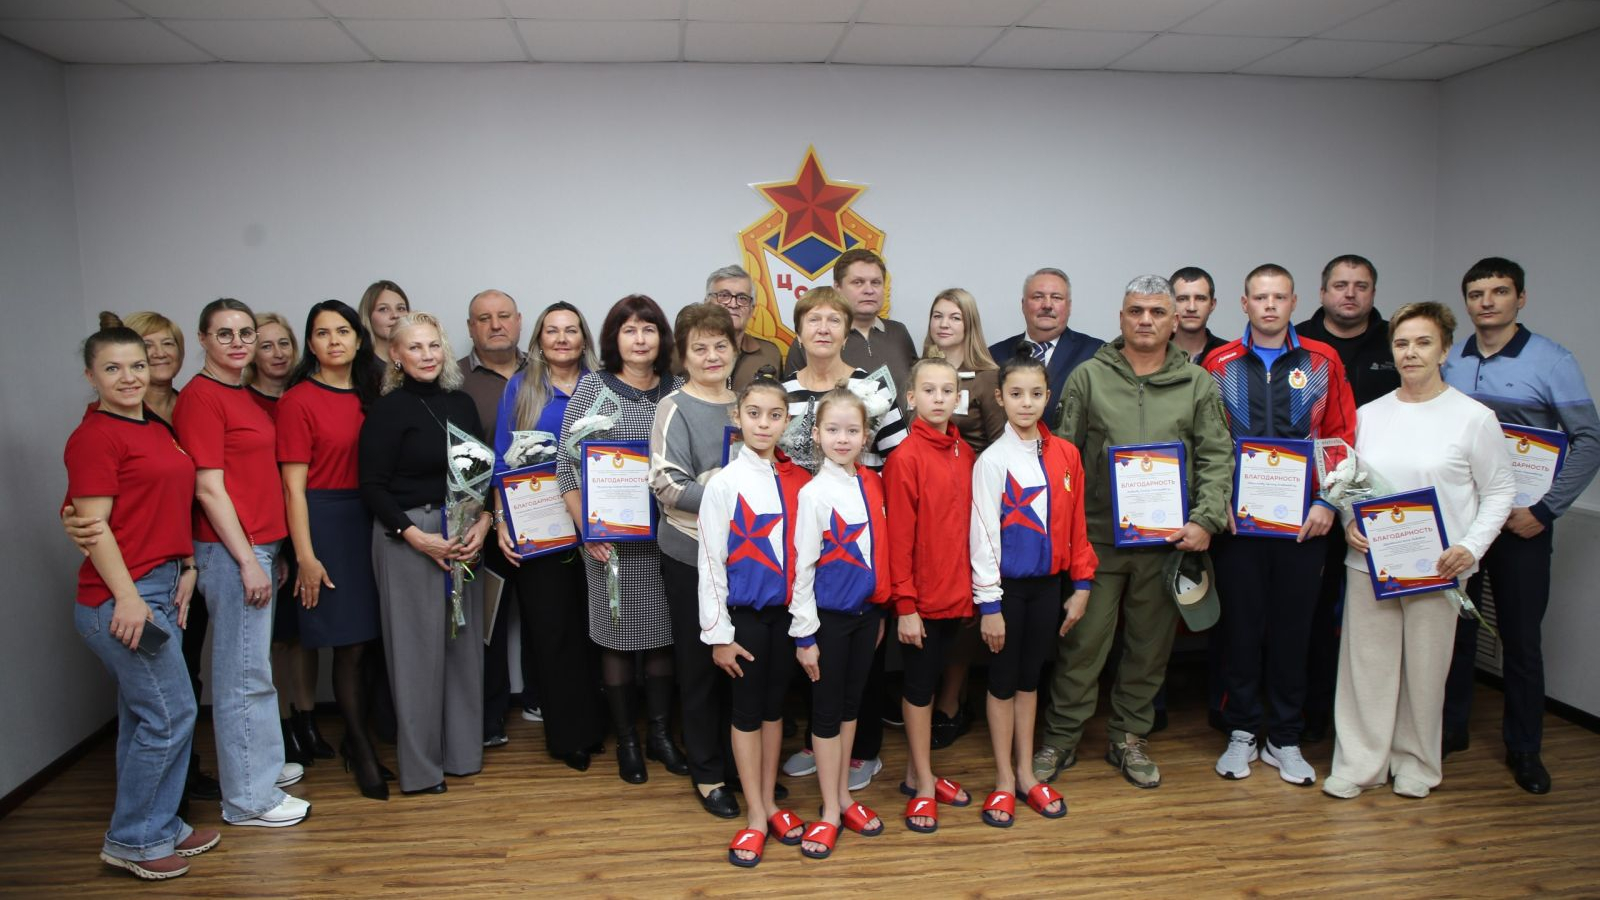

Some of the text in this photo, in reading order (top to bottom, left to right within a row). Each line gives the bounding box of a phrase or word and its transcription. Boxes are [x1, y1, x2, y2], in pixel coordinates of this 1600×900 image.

[1511, 461, 1550, 472] ДАРНОСТЬ
[1244, 473, 1301, 483] БЛАГОДАРНОСТЬ
[1121, 479, 1176, 489] БЛАГОДАРНОСТЬ
[513, 494, 563, 510] БЛАГОДАРНОСТ
[1372, 526, 1434, 542] БЛАГОДАРНОСТЬ
